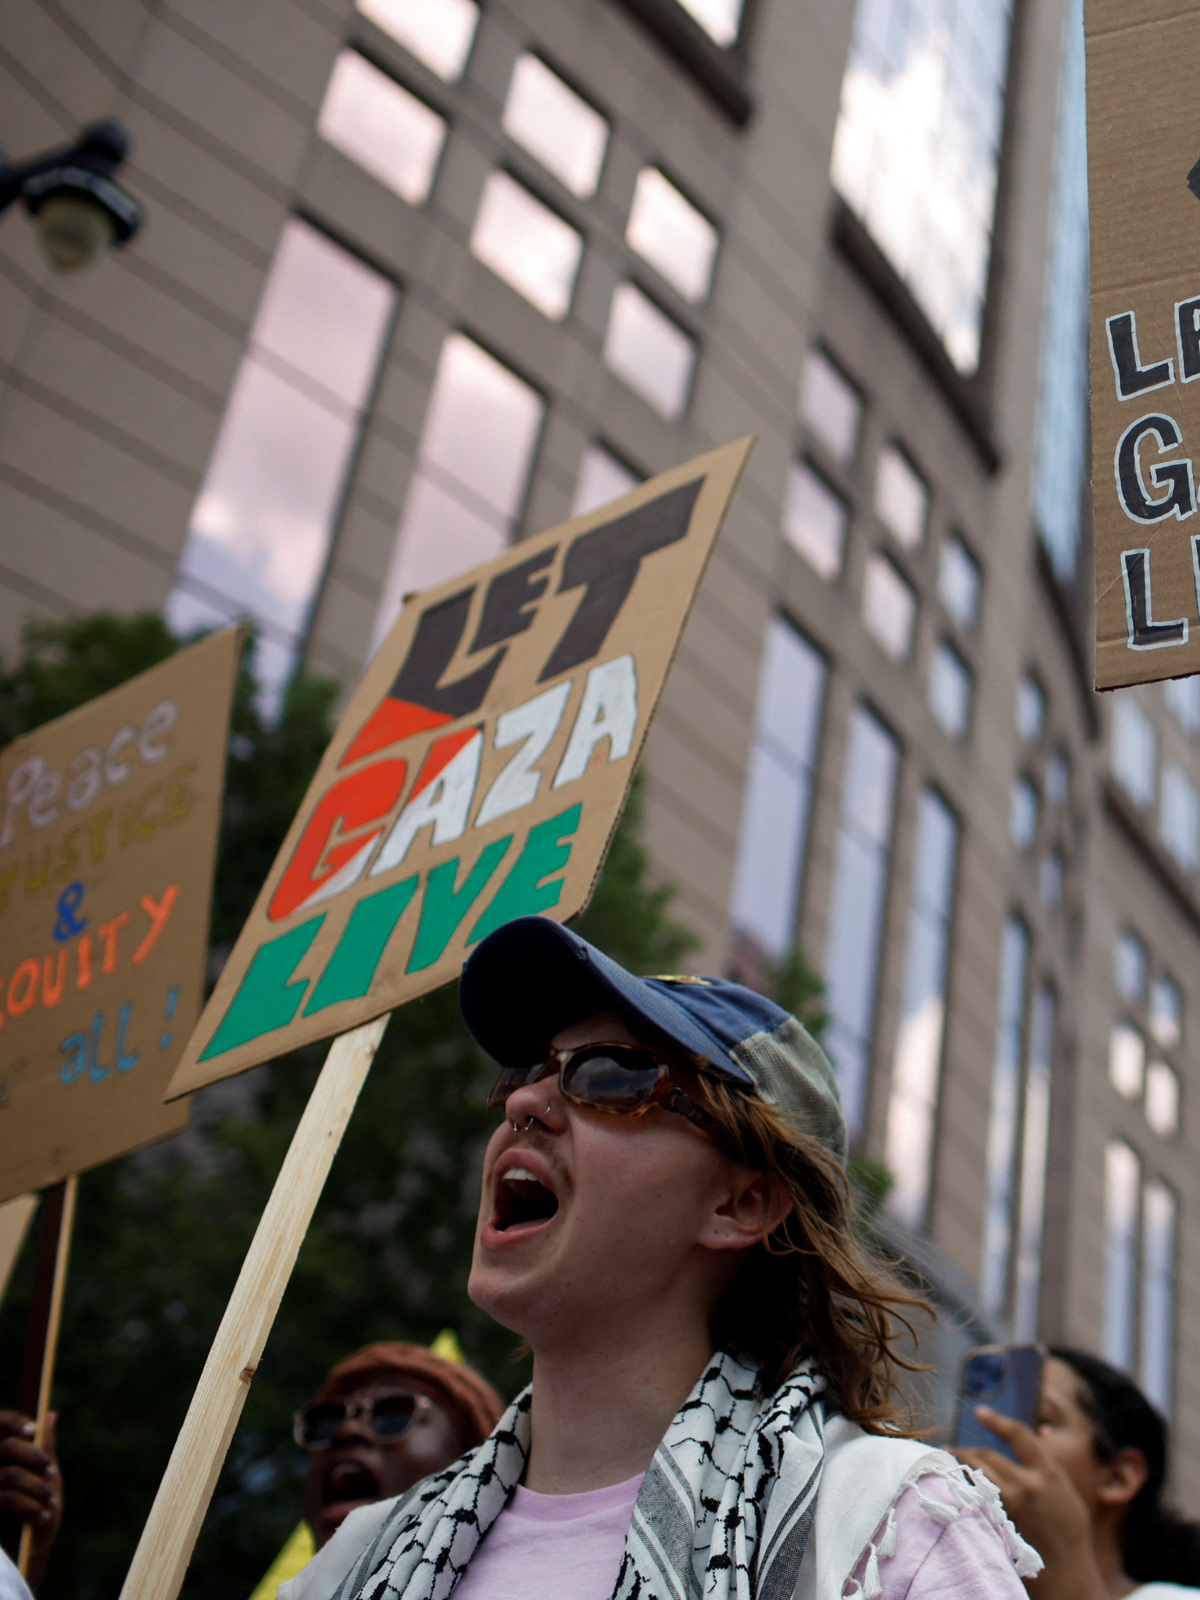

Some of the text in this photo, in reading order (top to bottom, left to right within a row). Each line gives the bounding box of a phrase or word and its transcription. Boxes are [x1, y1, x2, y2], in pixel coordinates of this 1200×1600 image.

[336, 473, 708, 771] LET
[2, 700, 180, 848] Peace
[267, 653, 638, 922] GAZA
[0, 882, 180, 1028] QUITY
[53, 880, 88, 942] &
[196, 802, 583, 1063] LIVE
